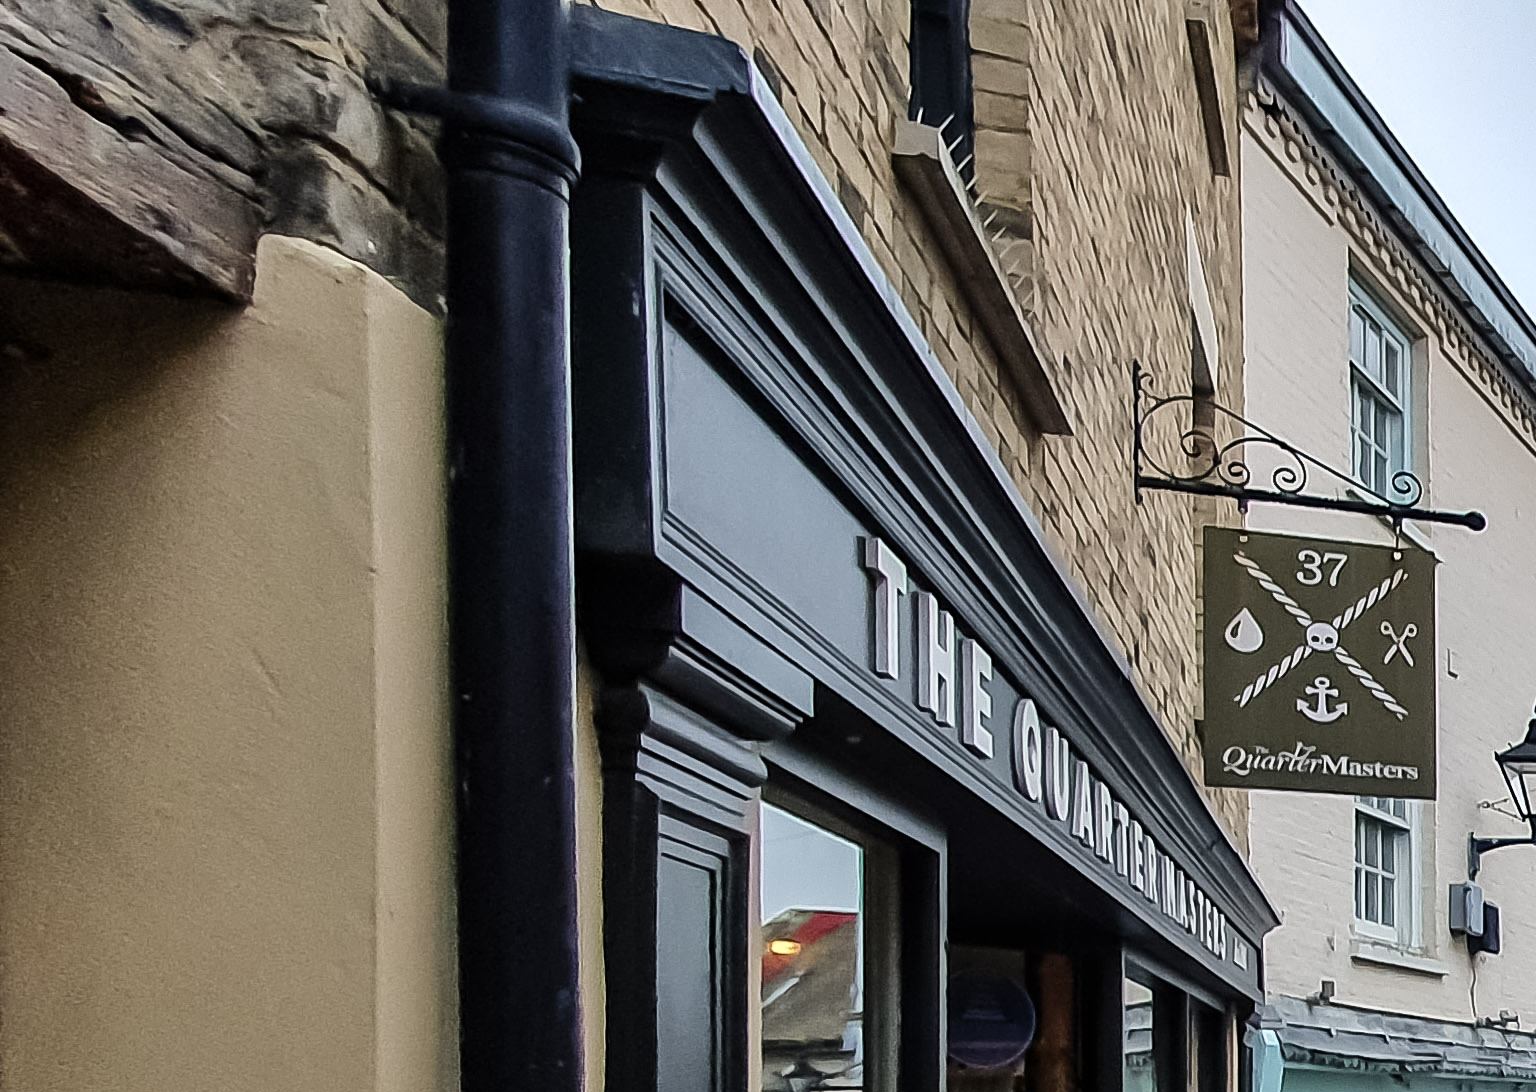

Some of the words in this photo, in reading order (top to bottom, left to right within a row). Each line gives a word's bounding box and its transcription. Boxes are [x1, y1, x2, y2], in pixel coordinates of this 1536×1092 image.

[1296, 550, 1349, 587] 37
[864, 536, 994, 761] THE
[1222, 741, 1419, 781] QuarterMasters
